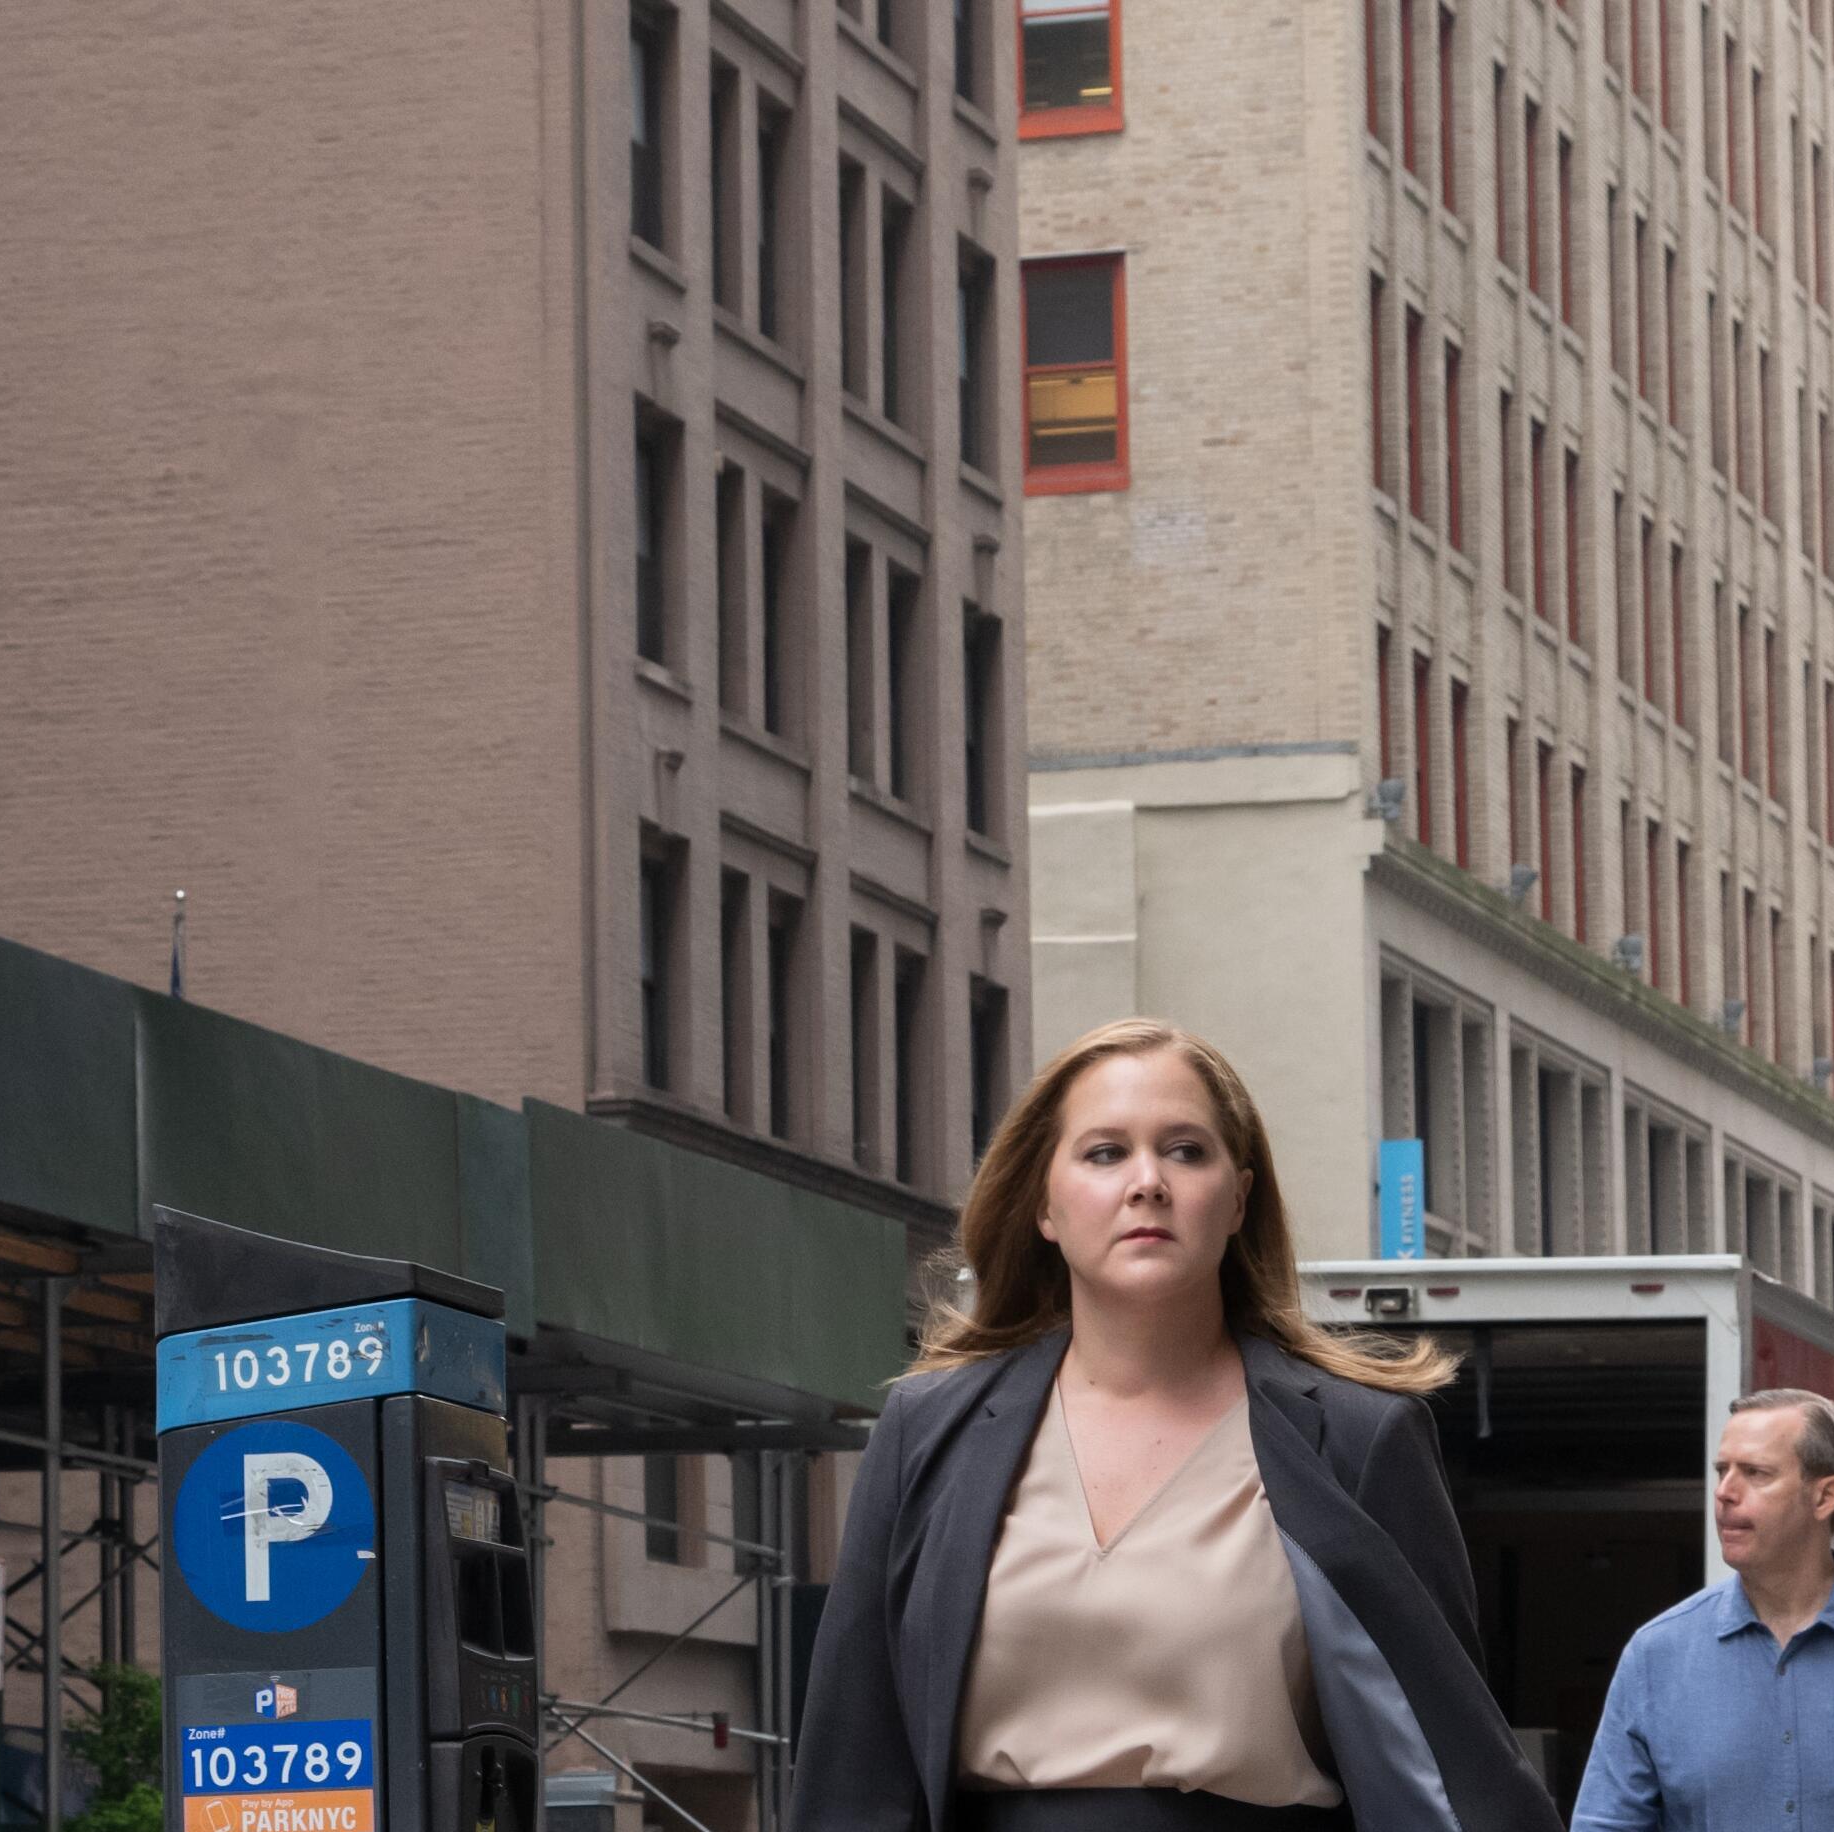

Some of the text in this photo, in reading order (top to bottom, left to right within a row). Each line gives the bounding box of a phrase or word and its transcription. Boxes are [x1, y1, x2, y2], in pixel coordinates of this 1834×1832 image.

[1399, 1174, 1415, 1244] FITNESS
[214, 1336, 383, 1391] 103789
[243, 1452, 333, 1602] P
[188, 1727, 226, 1741] Zone#
[191, 1741, 363, 1788] 103789
